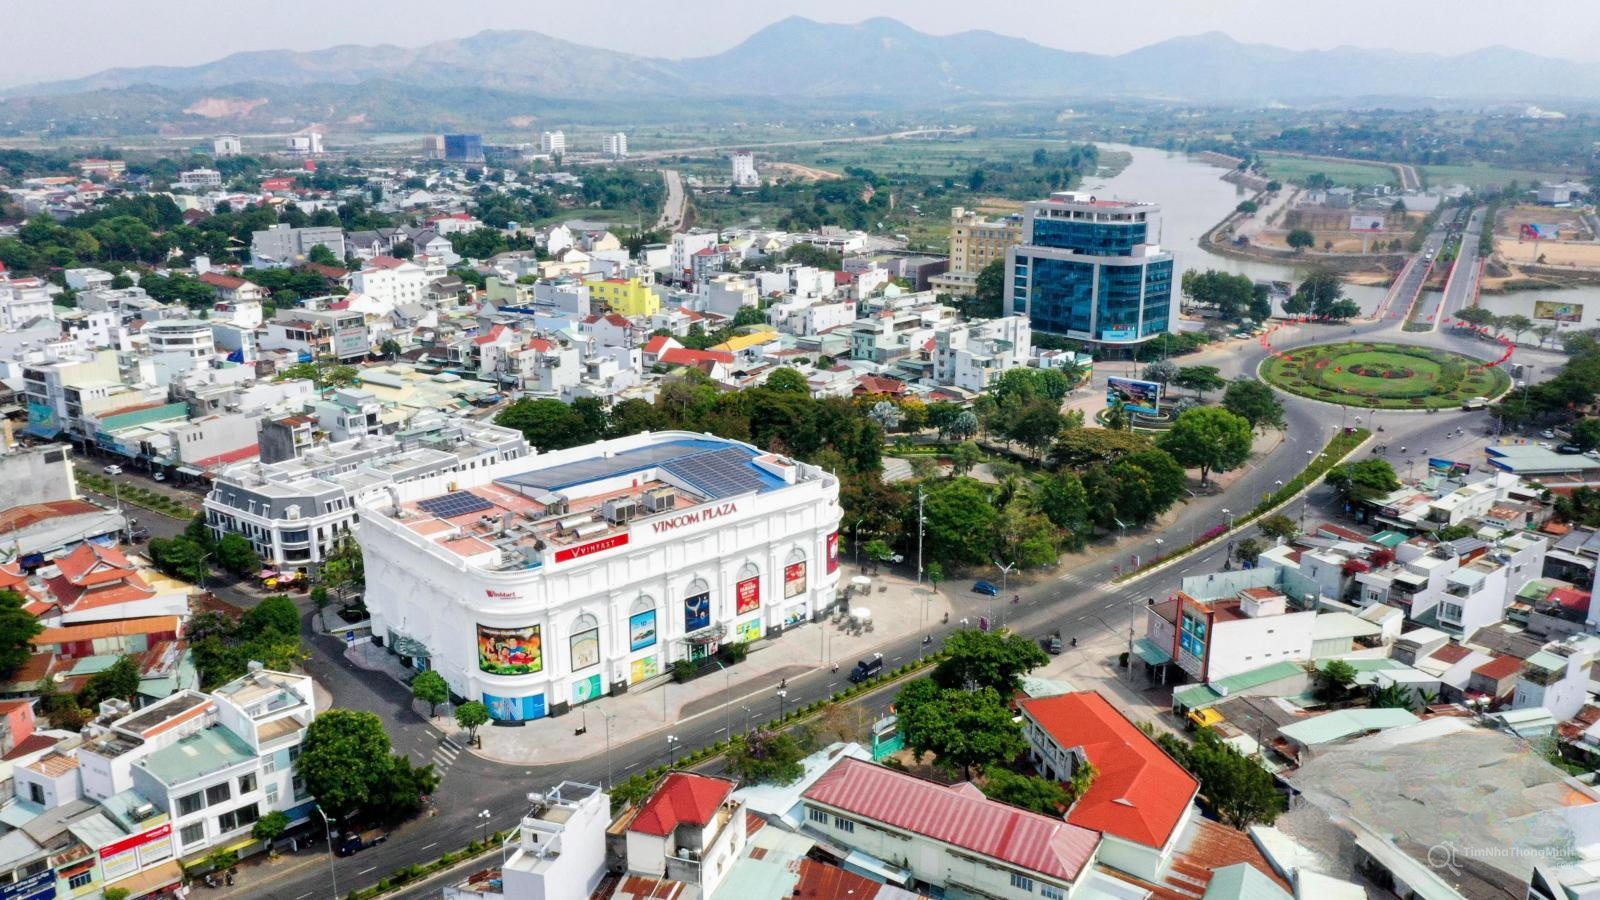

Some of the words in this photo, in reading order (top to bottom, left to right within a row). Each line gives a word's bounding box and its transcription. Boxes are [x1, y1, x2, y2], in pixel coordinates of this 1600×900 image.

[652, 512, 700, 534] VINCOM
[702, 502, 737, 521] PLAZA
[486, 589, 516, 598] WinMart
